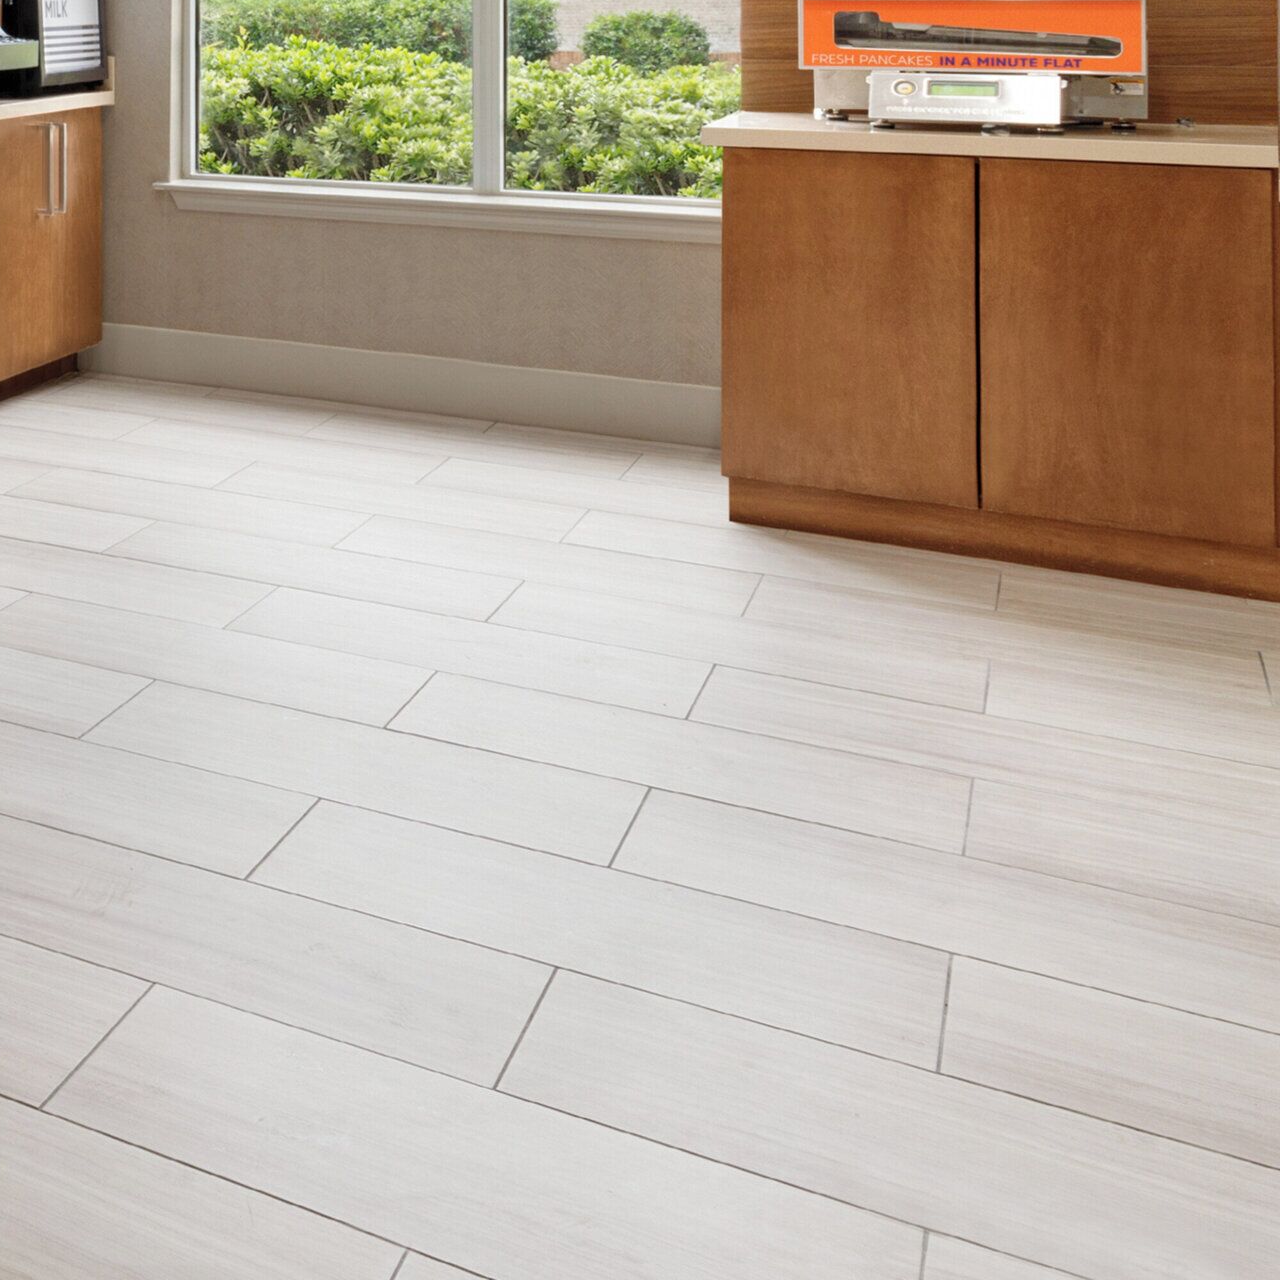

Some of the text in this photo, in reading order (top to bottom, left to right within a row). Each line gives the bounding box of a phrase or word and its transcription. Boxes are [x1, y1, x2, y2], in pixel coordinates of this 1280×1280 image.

[44, 0, 68, 19] MILK
[811, 53, 1083, 69] FRESH PANCAKES IN A MINUTE FLAT
